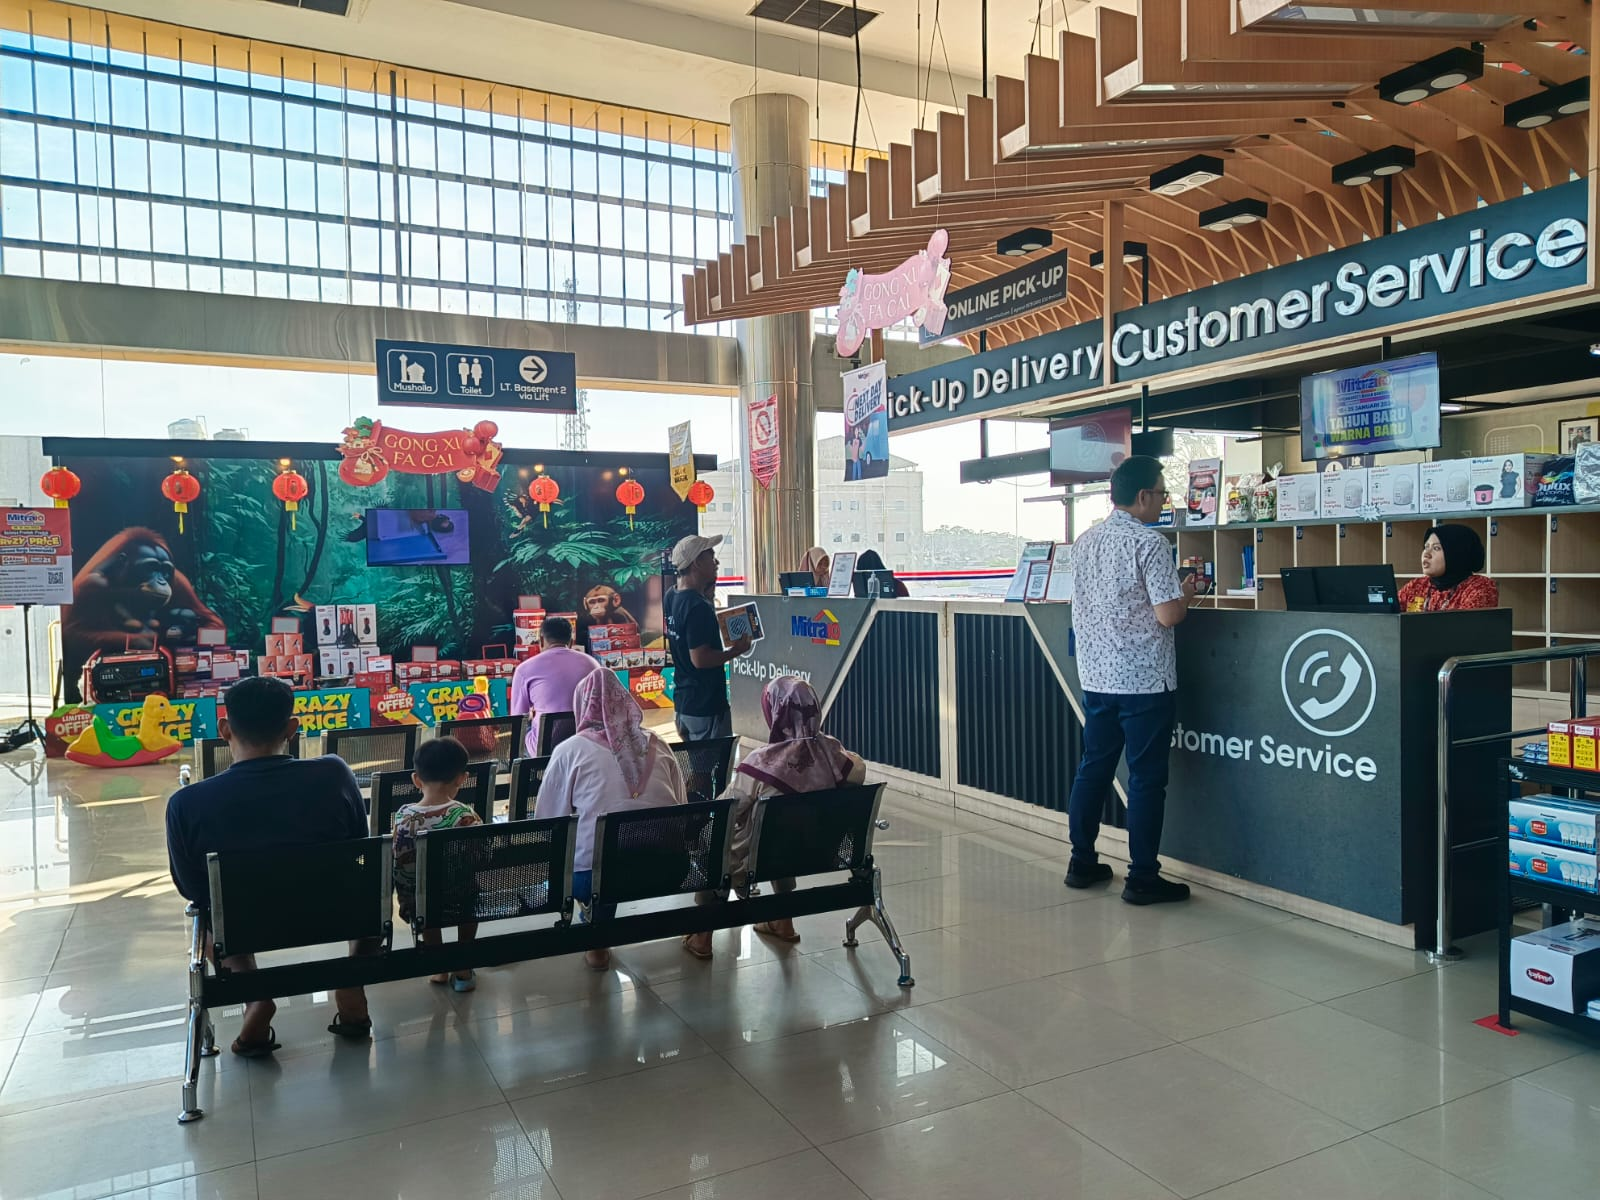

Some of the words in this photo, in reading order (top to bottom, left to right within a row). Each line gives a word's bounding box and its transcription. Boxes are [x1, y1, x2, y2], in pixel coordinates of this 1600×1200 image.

[947, 289, 999, 321] ONLINE
[1003, 265, 1064, 304] PICK-UP
[1112, 280, 1331, 366] Customer
[1335, 217, 1587, 316] Service
[393, 382, 433, 392] Musholla
[460, 385, 483, 395] Toilet
[500, 382, 512, 391] LT.
[514, 384, 560, 394] Basement
[560, 386, 567, 394] 2
[888, 377, 965, 418] ick-Up
[973, 342, 1104, 400] Delivery
[534, 392, 550, 401] Lift
[855, 389, 870, 410] NEXT
[870, 378, 882, 397] DAY
[854, 391, 882, 422] DELIVERY
[1329, 411, 1370, 433] TAHUN
[1372, 407, 1407, 425] BARU
[384, 433, 438, 453] GONG
[441, 437, 460, 450] XI
[1330, 426, 1371, 443] WARNA
[1374, 422, 1406, 438] BARU
[393, 451, 416, 467] FA
[421, 453, 454, 468] CAI
[733, 658, 767, 681] Pick-Up
[635, 679, 665, 692] OFFER
[293, 693, 352, 714] RAZY
[377, 697, 414, 712] OFFER
[299, 711, 348, 732] RICE
[1258, 734, 1377, 782] Service
